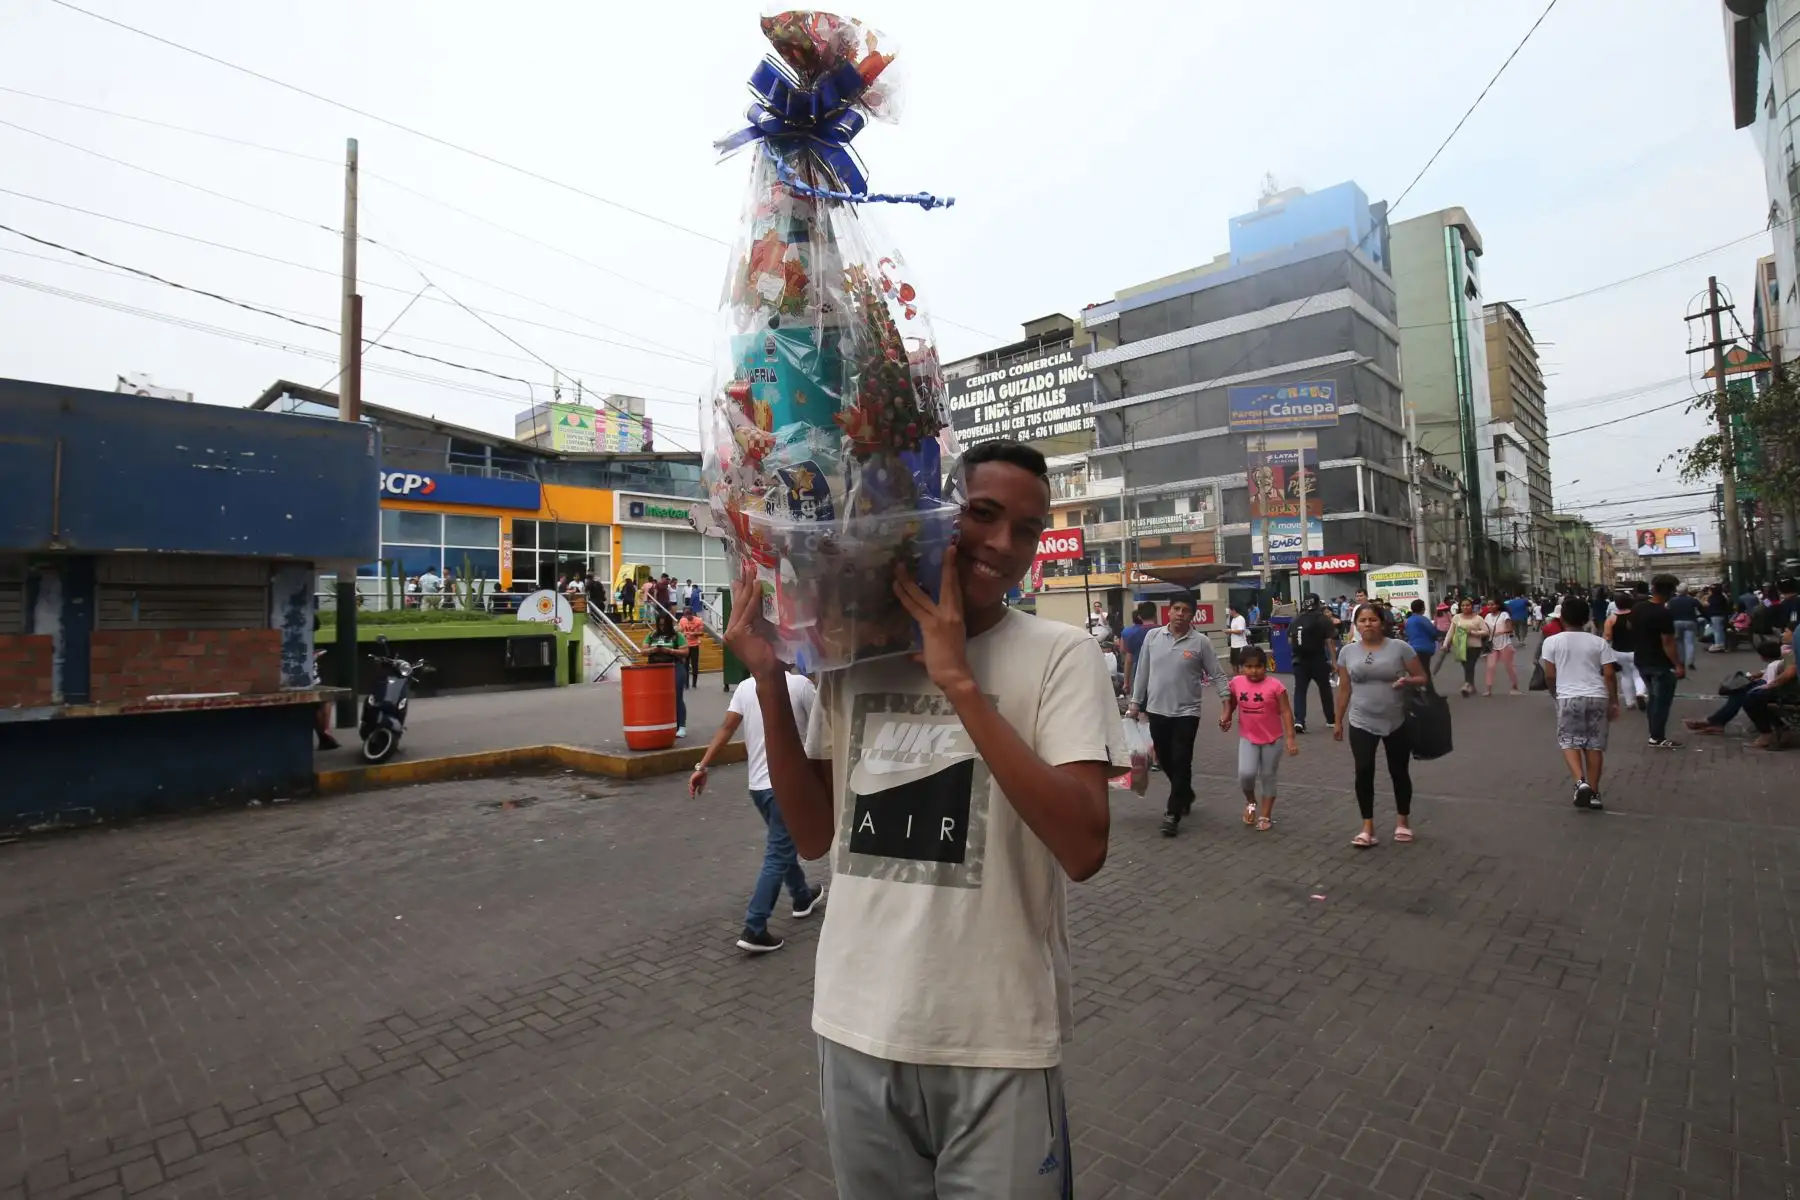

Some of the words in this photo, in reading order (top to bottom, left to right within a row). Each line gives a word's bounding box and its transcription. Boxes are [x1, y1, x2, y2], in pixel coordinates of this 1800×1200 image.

[966, 369, 1006, 388] CENTRO
[1009, 352, 1073, 376] COMERCIAL
[950, 385, 996, 411] GALERÍA
[999, 372, 1054, 399] GUIZADO
[975, 408, 981, 423] E
[995, 420, 1001, 432] A
[1027, 413, 1041, 426] TUS
[1043, 404, 1081, 422] COMPRAS
[1270, 402, 1335, 416] Cánepa
[1018, 430, 1030, 441] 674
[1035, 427, 1047, 438] 676
[1049, 425, 1054, 435] Y
[1054, 419, 1081, 434] UNANUE
[645, 503, 689, 519] Interban
[1278, 521, 1314, 529] movisar
[1037, 537, 1079, 554] AÑOS
[1315, 559, 1355, 570] BAÑOS
[862, 721, 965, 763] NIKE
[858, 811, 955, 842] AIR
